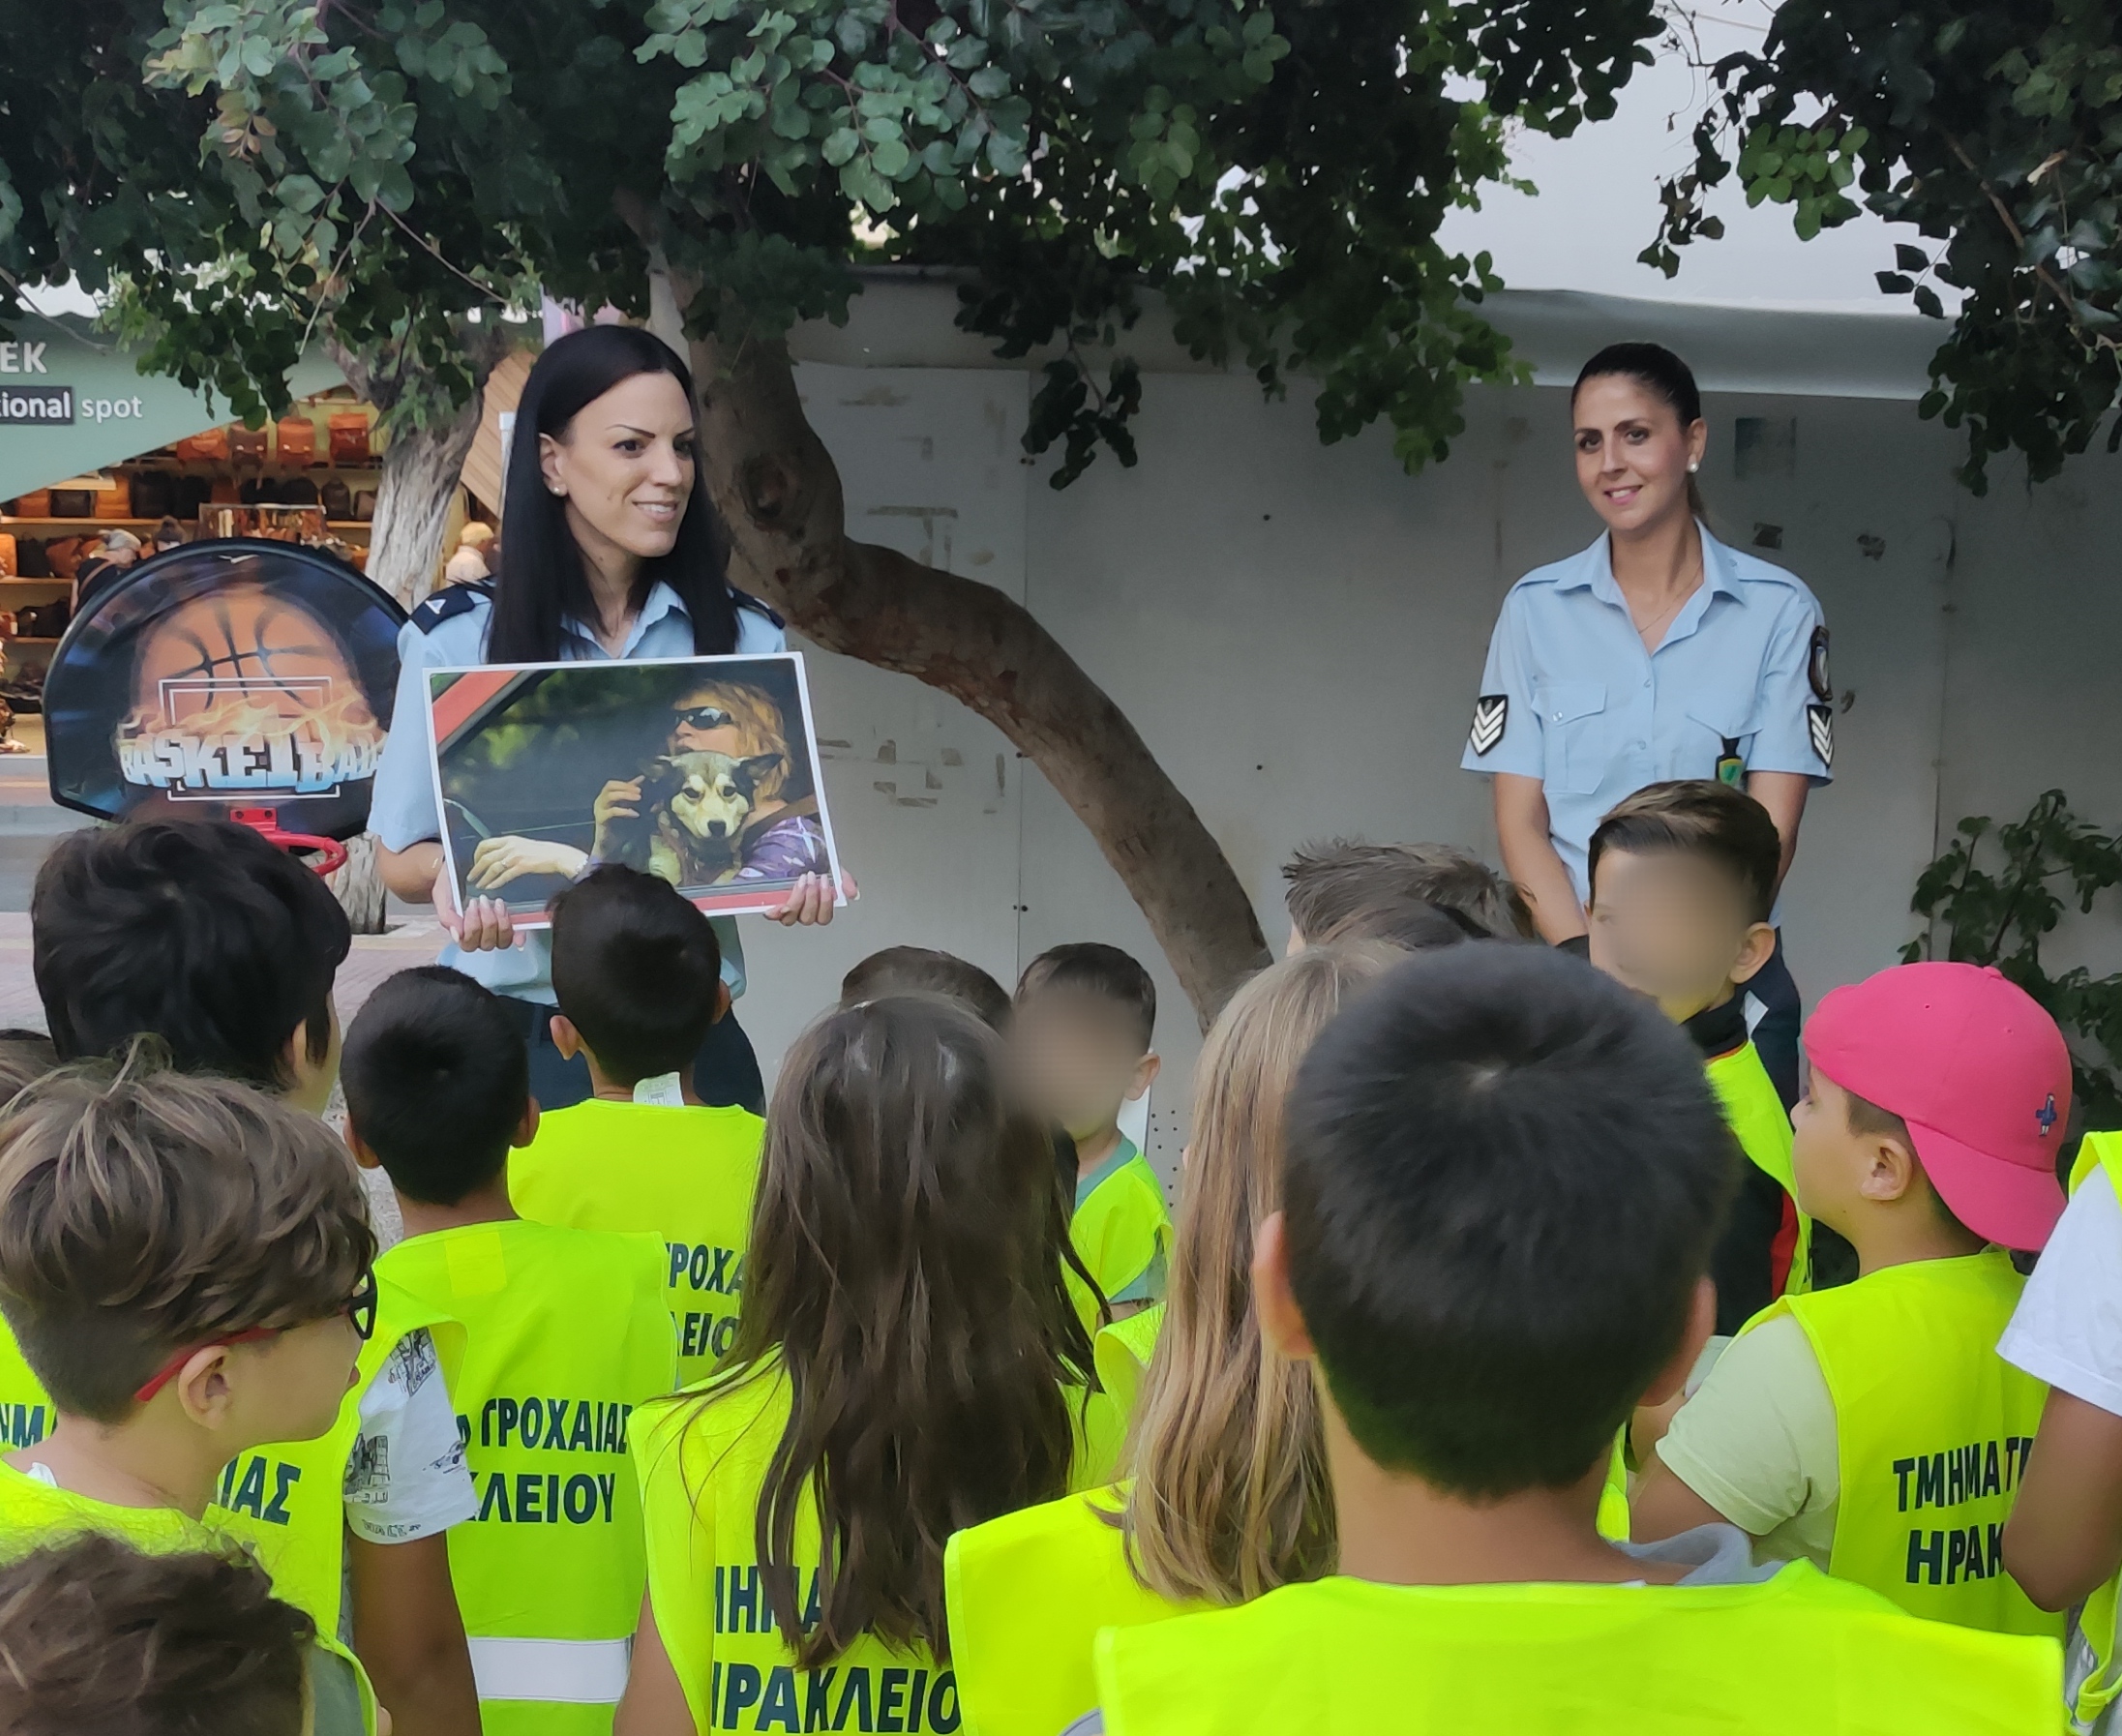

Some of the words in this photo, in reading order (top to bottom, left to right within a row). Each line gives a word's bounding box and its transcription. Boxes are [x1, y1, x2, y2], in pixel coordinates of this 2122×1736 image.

[0, 391, 71, 418] ional
[81, 395, 143, 423] spot
[466, 1472, 615, 1524] ΛΕΙΟΥ
